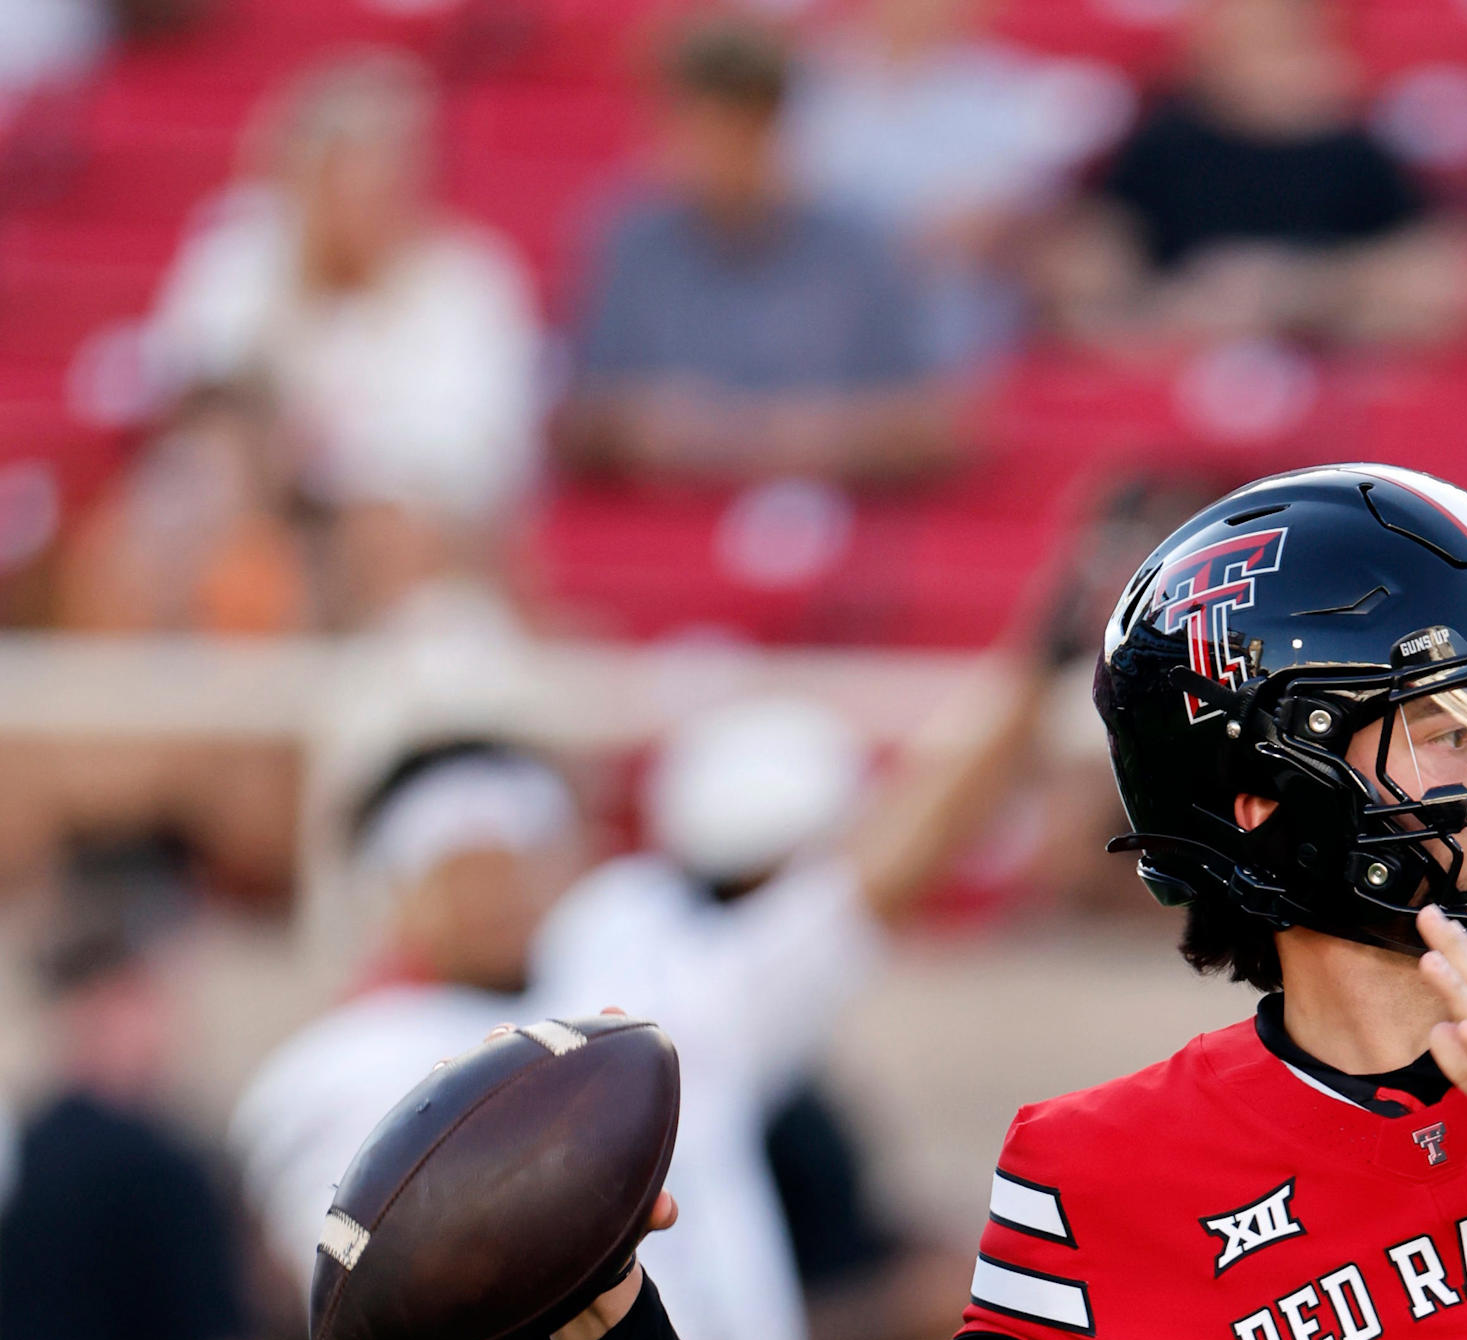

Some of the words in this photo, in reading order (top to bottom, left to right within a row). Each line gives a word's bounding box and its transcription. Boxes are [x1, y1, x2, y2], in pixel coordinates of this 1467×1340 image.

[1400, 634, 1432, 657] GUNS
[1432, 628, 1450, 646] UP
[1203, 1181, 1303, 1272] XII
